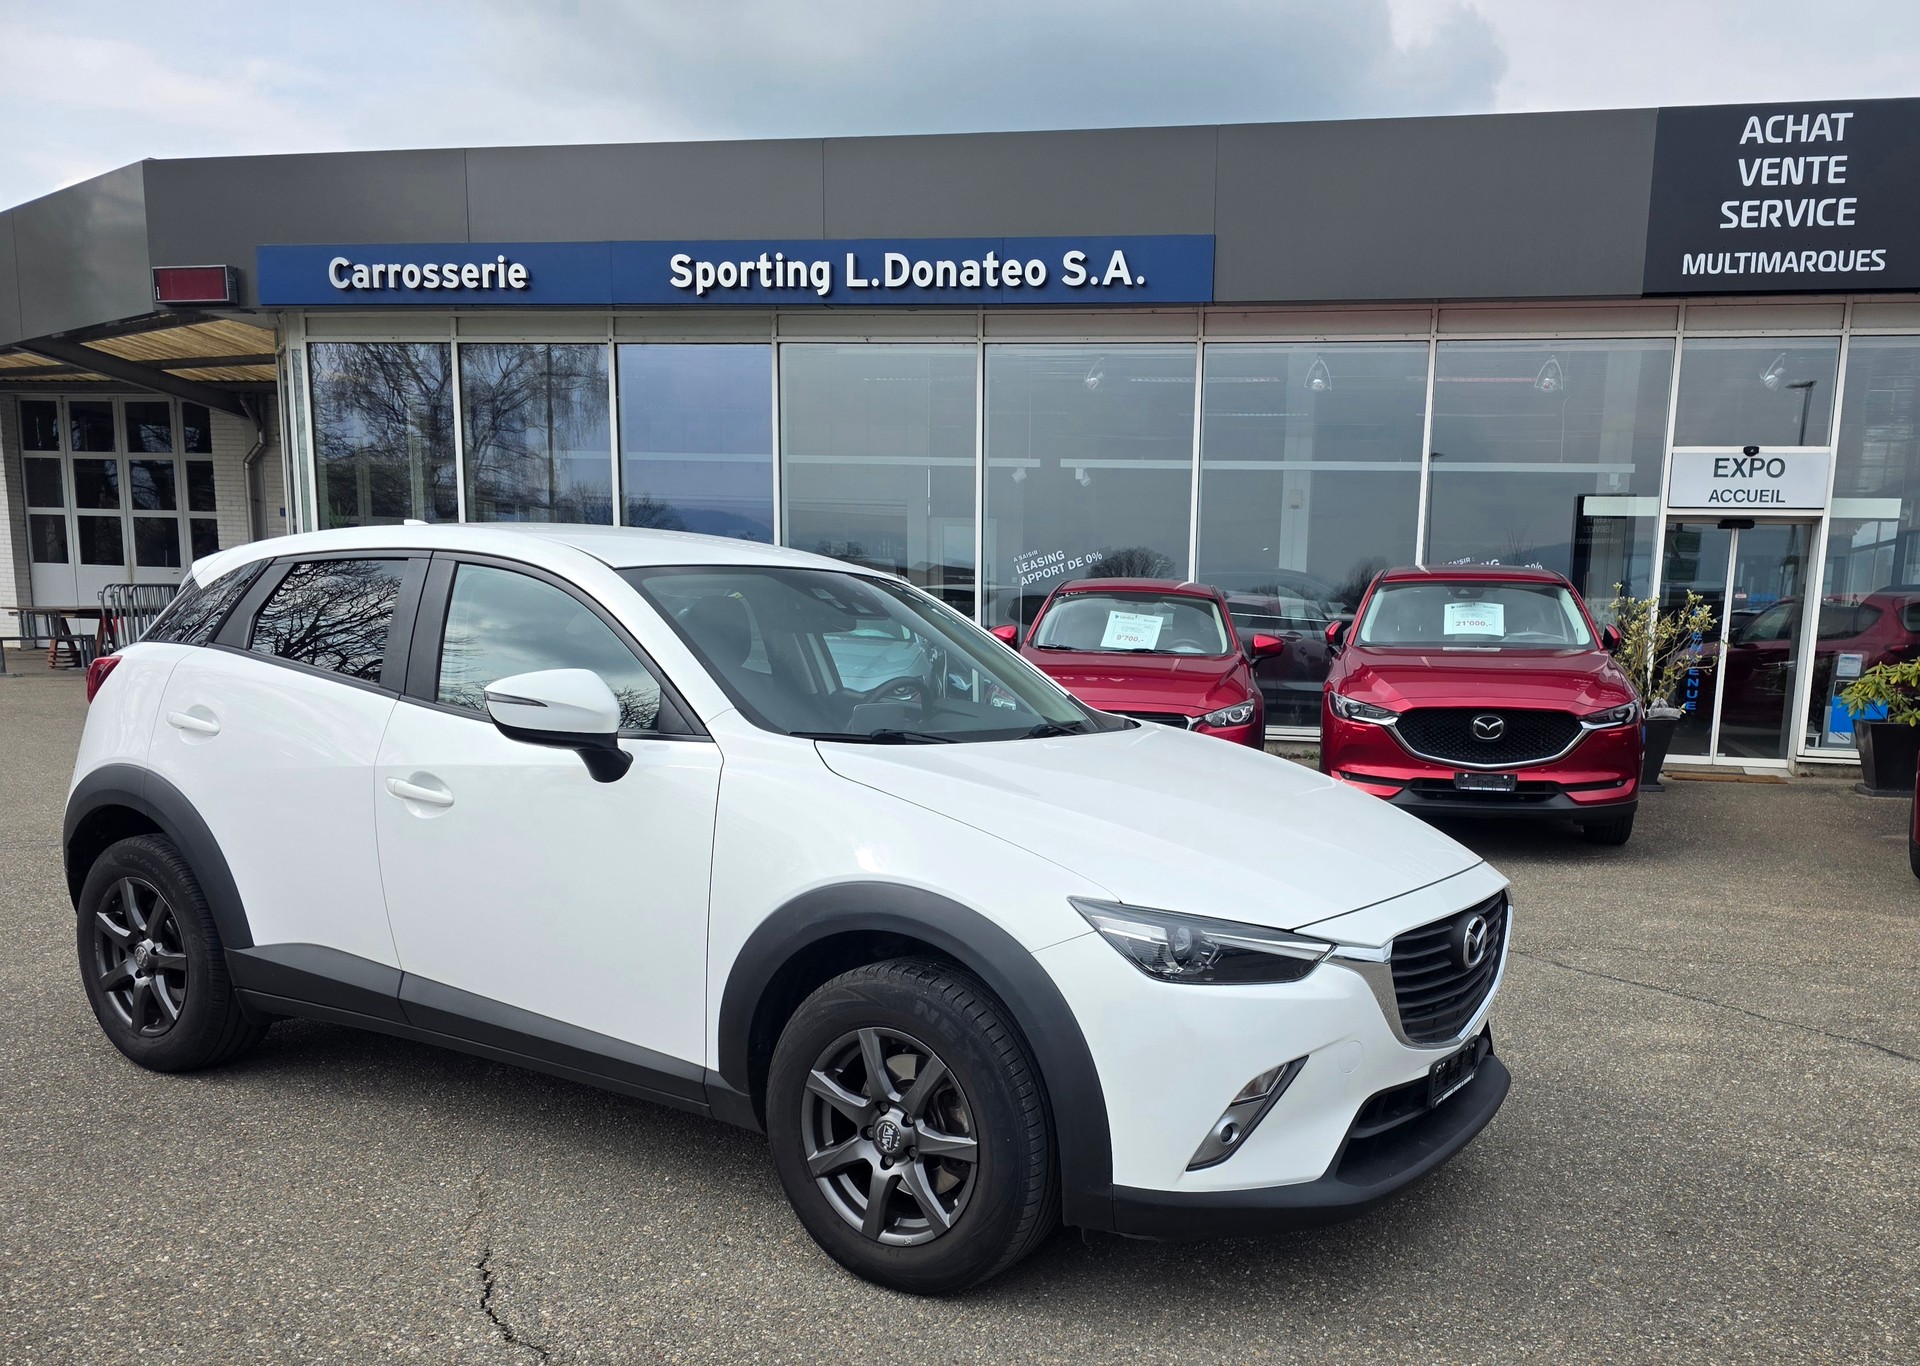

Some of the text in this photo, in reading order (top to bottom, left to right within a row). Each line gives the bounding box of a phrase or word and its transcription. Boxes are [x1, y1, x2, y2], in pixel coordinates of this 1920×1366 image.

[1739, 112, 1854, 145] ACHAT
[1738, 155, 1848, 187] VENTE
[1719, 197, 1858, 229] SERVICE
[328, 254, 529, 290] Carrosserie
[669, 251, 832, 296] Sporting
[1061, 249, 1147, 287] S.A.
[1682, 249, 1887, 275] MULTIMARQUES
[1713, 457, 1786, 479] EXPO
[1708, 489, 1786, 504] ACCUEIL
[1016, 550, 1065, 574] LEASING
[1018, 549, 1039, 561] SAISIR
[1021, 550, 1103, 587] APPORT DE 0%
